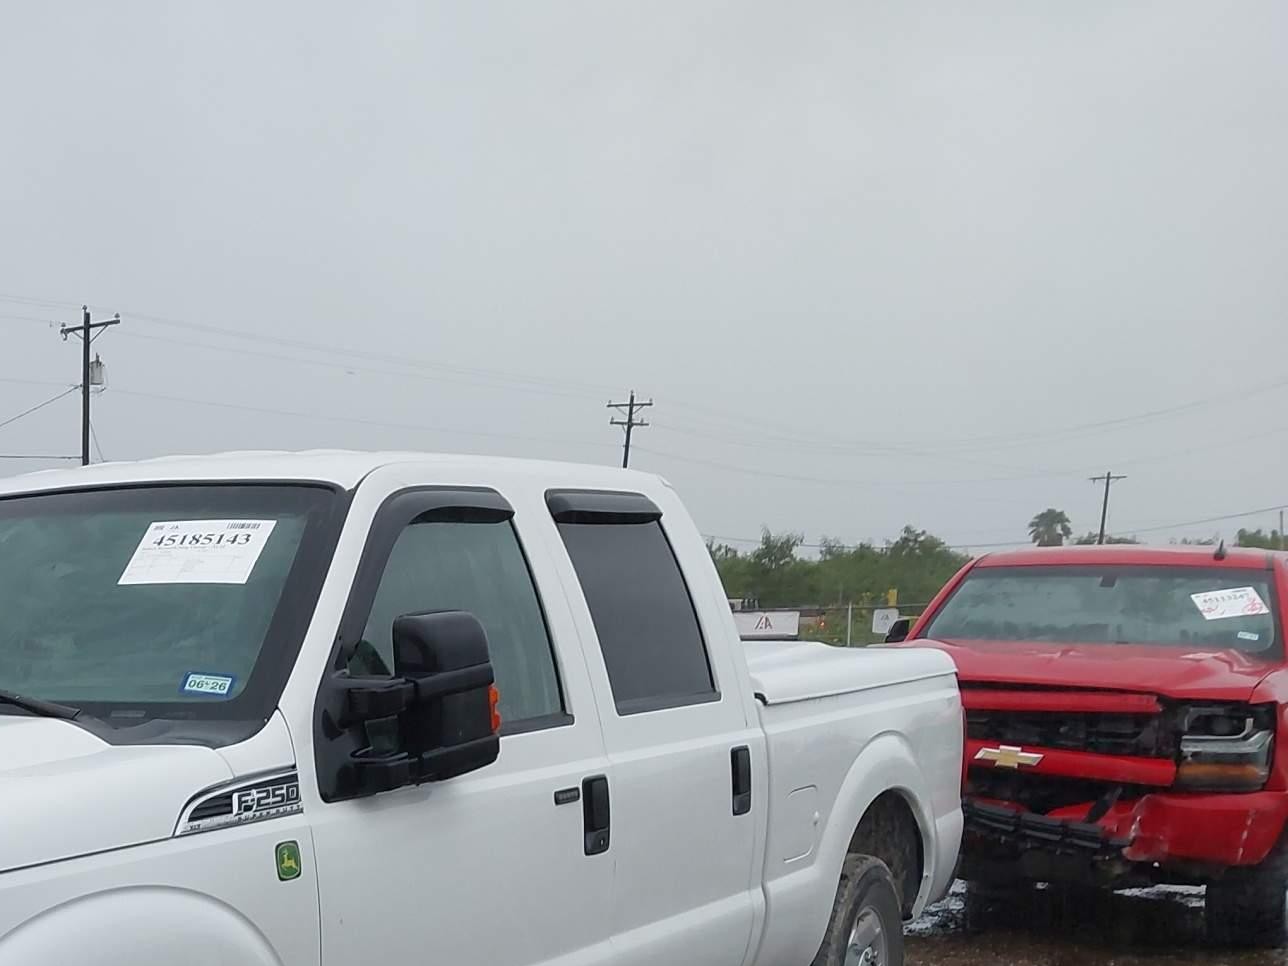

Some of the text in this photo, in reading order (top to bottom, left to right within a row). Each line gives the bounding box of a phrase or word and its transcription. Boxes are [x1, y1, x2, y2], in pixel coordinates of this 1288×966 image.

[153, 533, 253, 547] 45185143
[188, 679, 228, 691] 06 26
[232, 783, 302, 817] F-250
